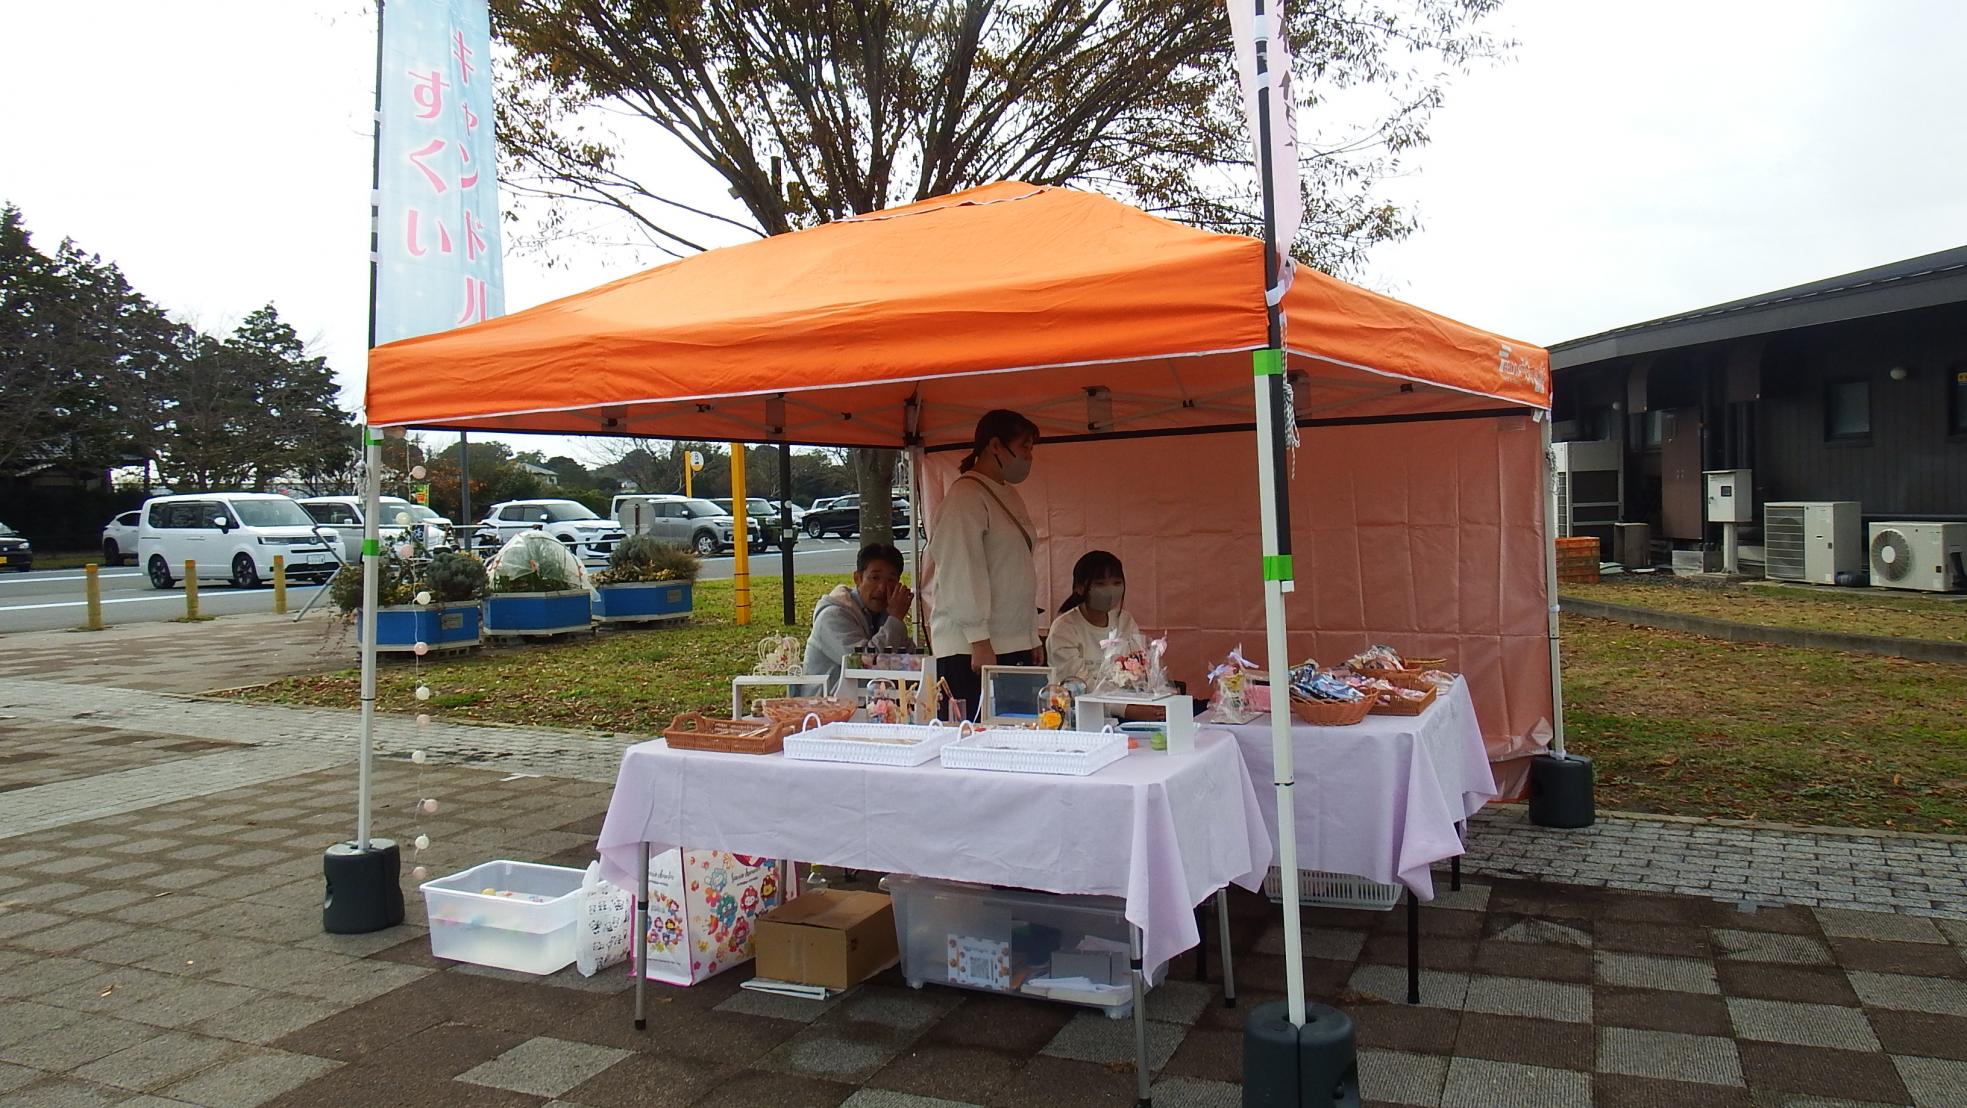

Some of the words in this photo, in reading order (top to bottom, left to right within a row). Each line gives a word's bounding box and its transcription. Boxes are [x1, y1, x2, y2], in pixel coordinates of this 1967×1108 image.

[408, 70, 452, 257] すくい
[453, 31, 487, 323] キャンドル
